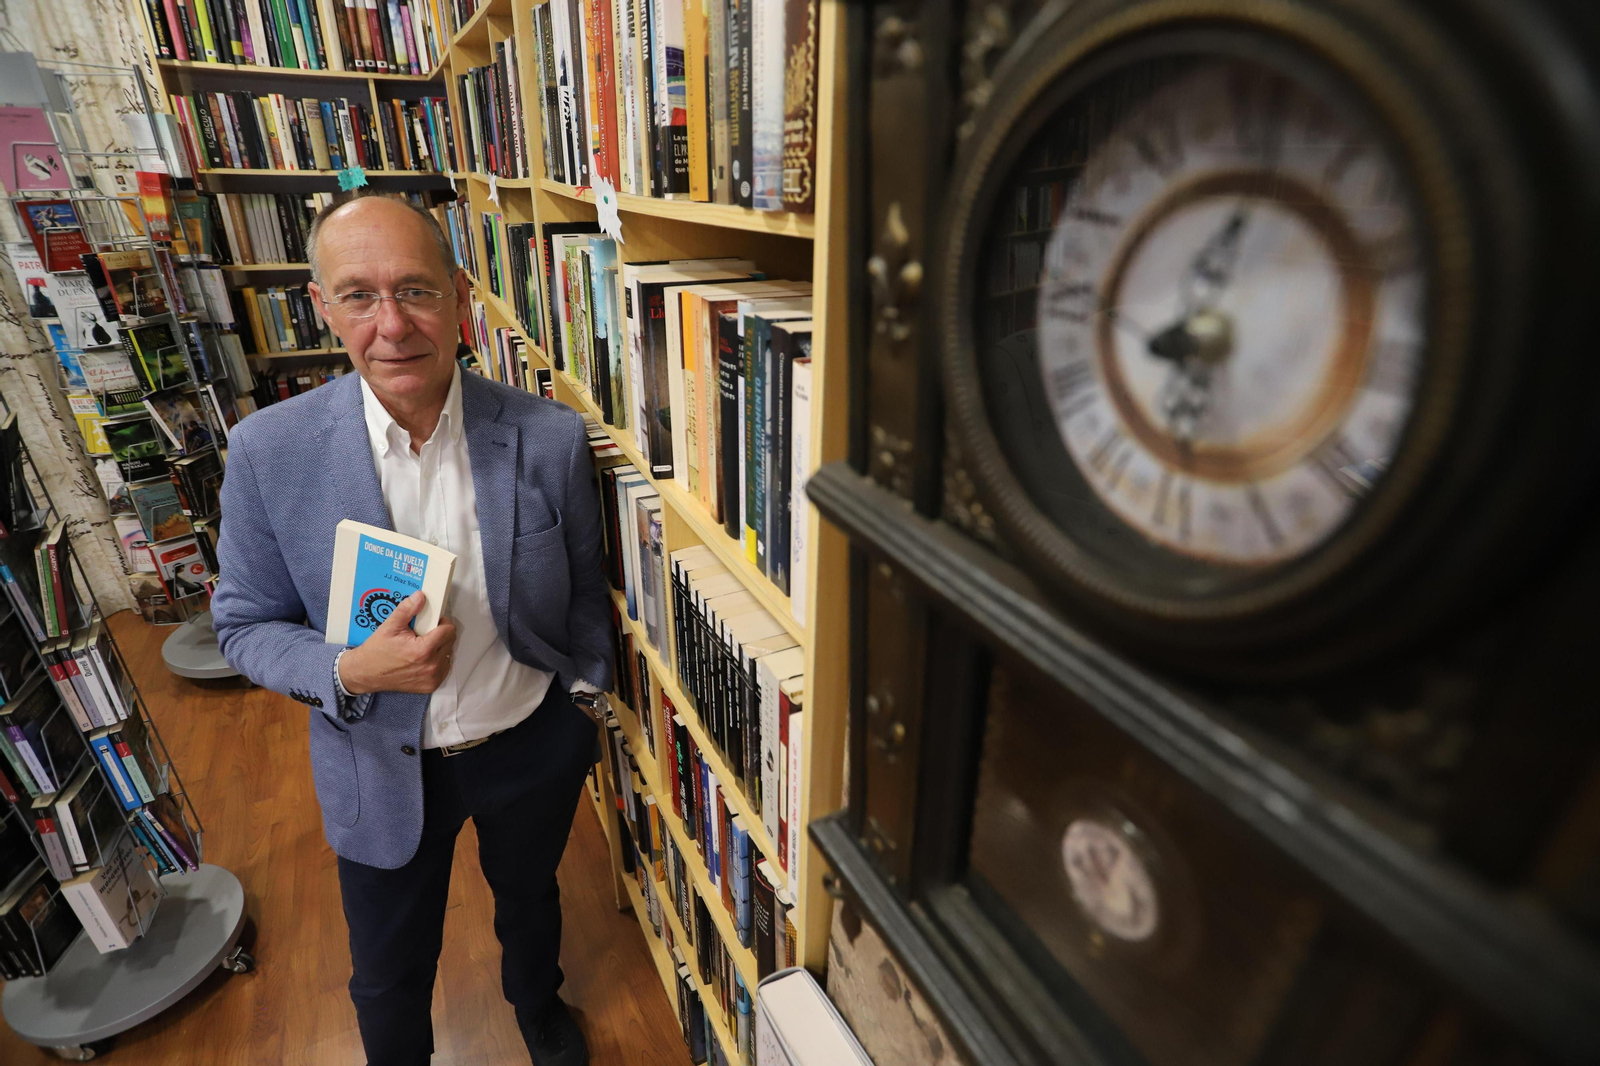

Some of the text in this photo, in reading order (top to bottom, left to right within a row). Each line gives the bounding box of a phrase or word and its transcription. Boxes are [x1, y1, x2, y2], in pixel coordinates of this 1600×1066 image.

[588, 245, 598, 285] LOST
[755, 376, 764, 462] TESTAMENTO
[755, 465, 764, 513] TERCER
[364, 541, 425, 569] DONDE DA LA VUELTA
[393, 559, 401, 570] EL
[402, 562, 423, 577] TIEMPO
[407, 580, 420, 590] Trillo
[78, 660, 93, 678] Durrell
